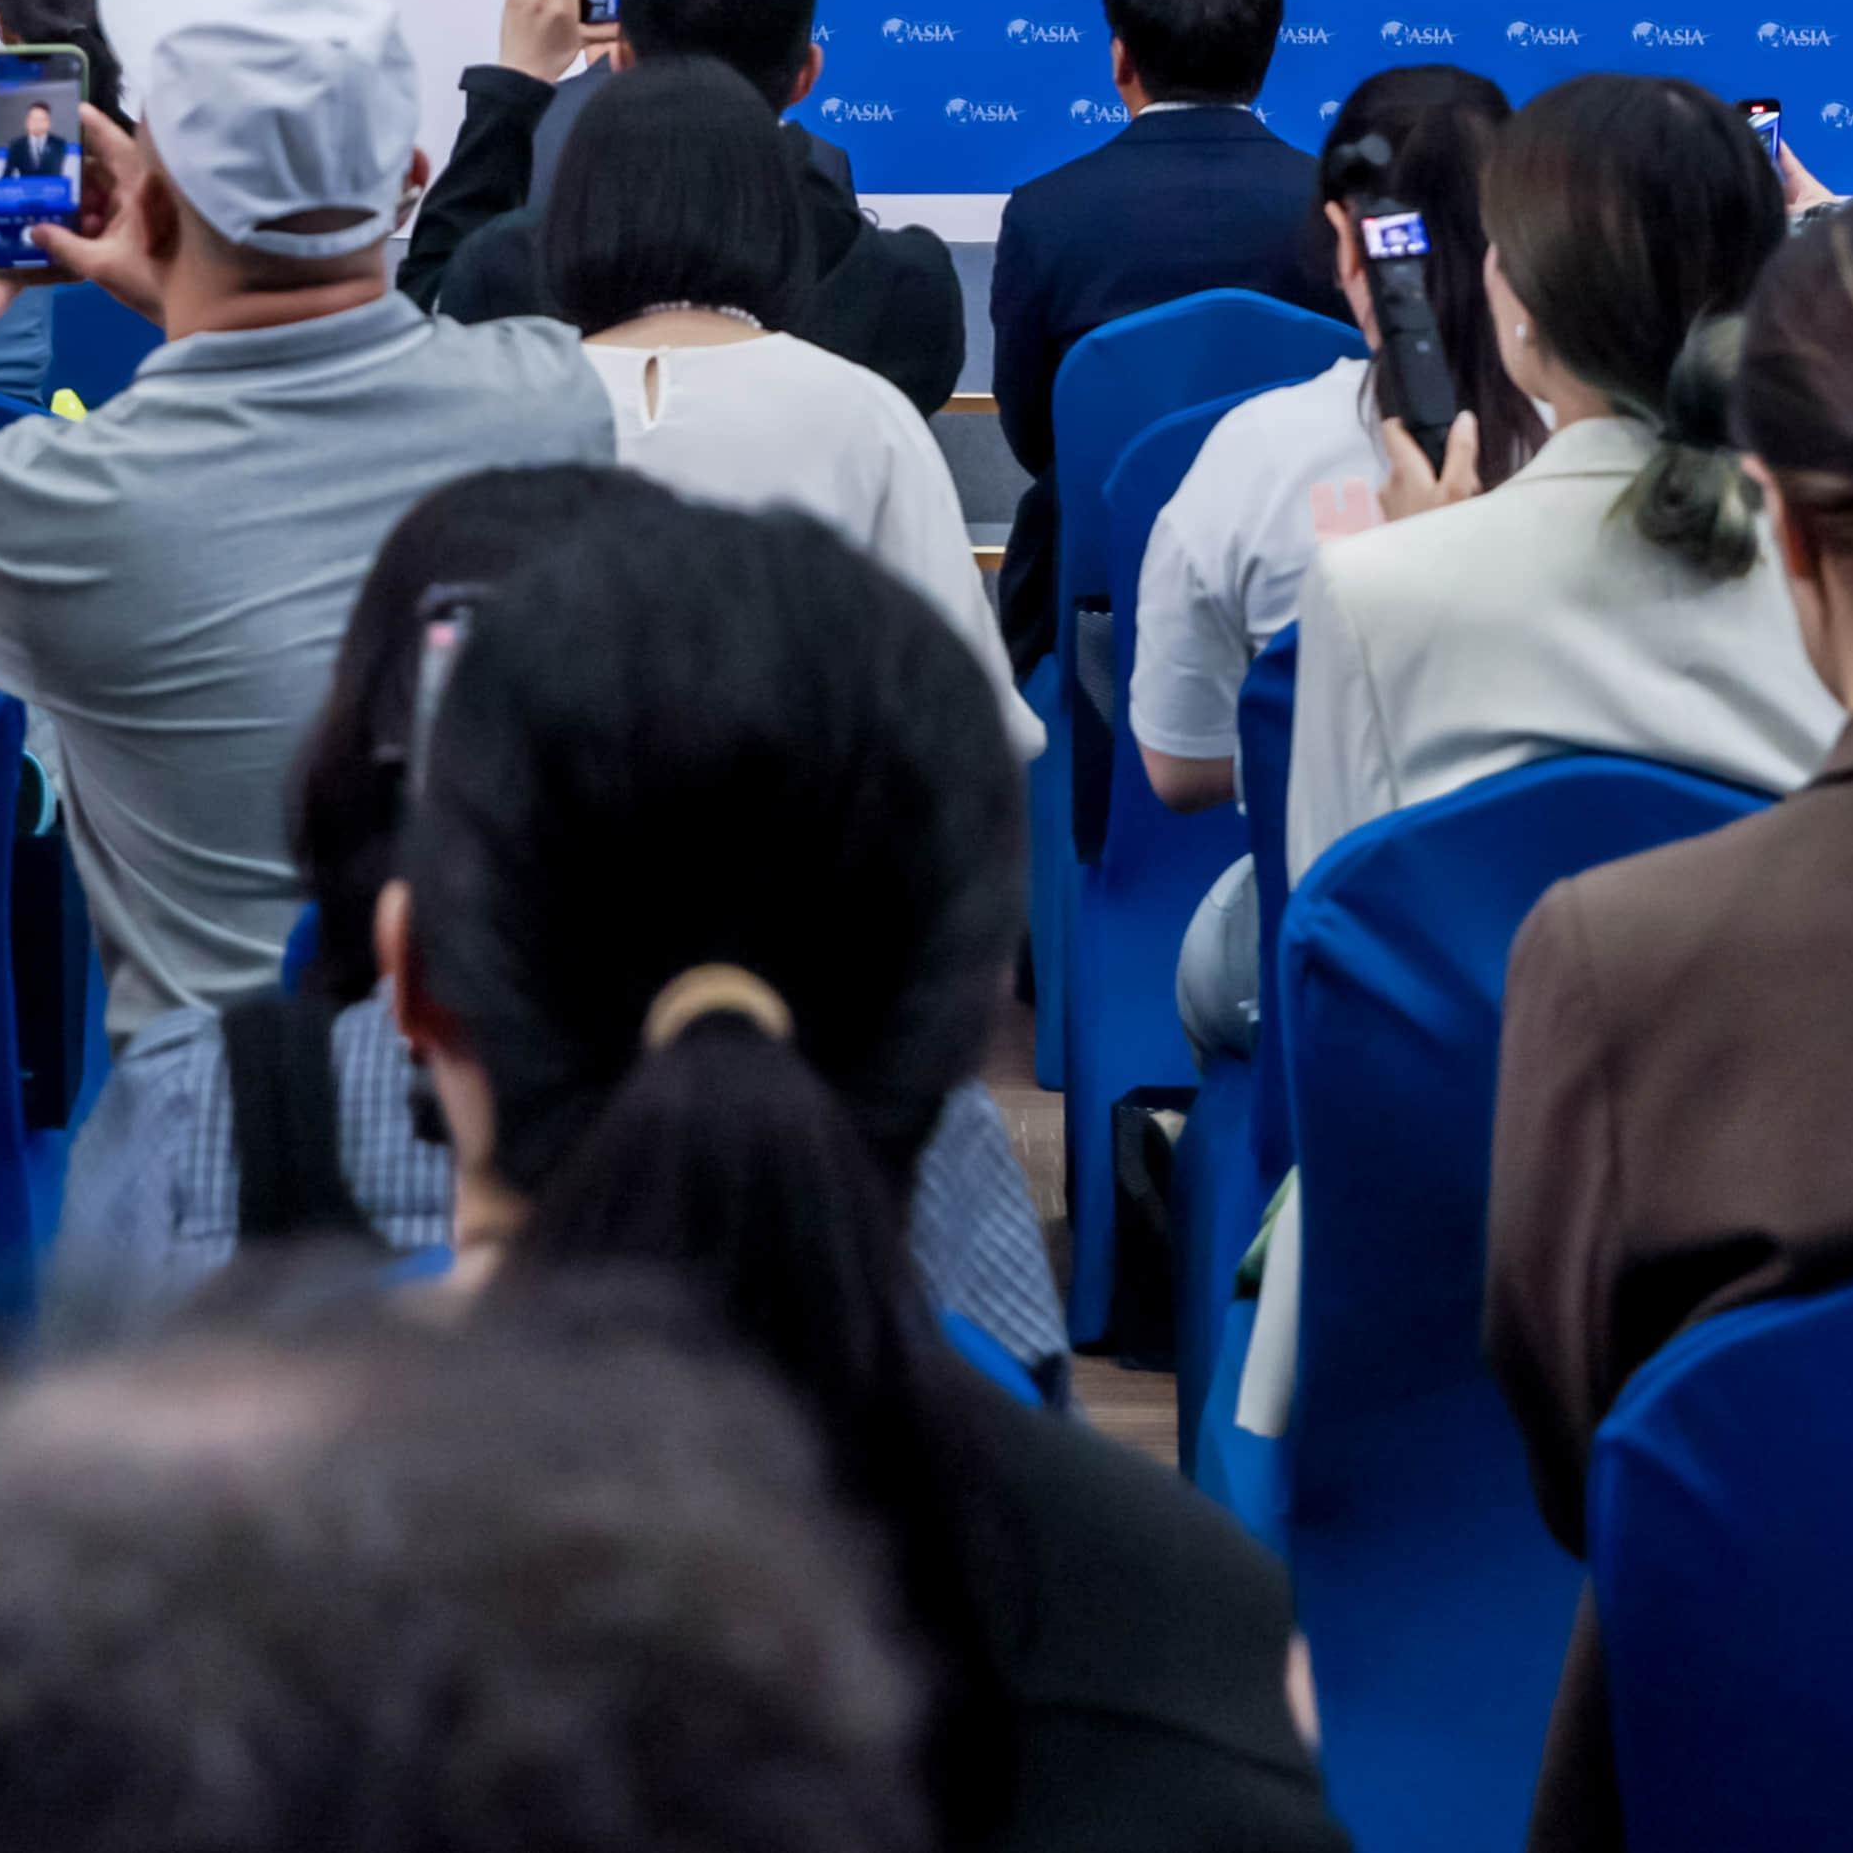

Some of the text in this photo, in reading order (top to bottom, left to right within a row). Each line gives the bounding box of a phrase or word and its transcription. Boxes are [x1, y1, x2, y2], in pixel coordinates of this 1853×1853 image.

[909, 24, 955, 42] ASIA
[1034, 25, 1080, 43] ASIA
[1283, 27, 1329, 45] ASIA
[1408, 27, 1454, 45] ASIA
[1533, 28, 1579, 46] ASIA
[1659, 28, 1705, 46] ASIA
[1785, 29, 1831, 47] ASIA
[848, 104, 894, 122] ASIA
[972, 104, 1018, 122] ASIA
